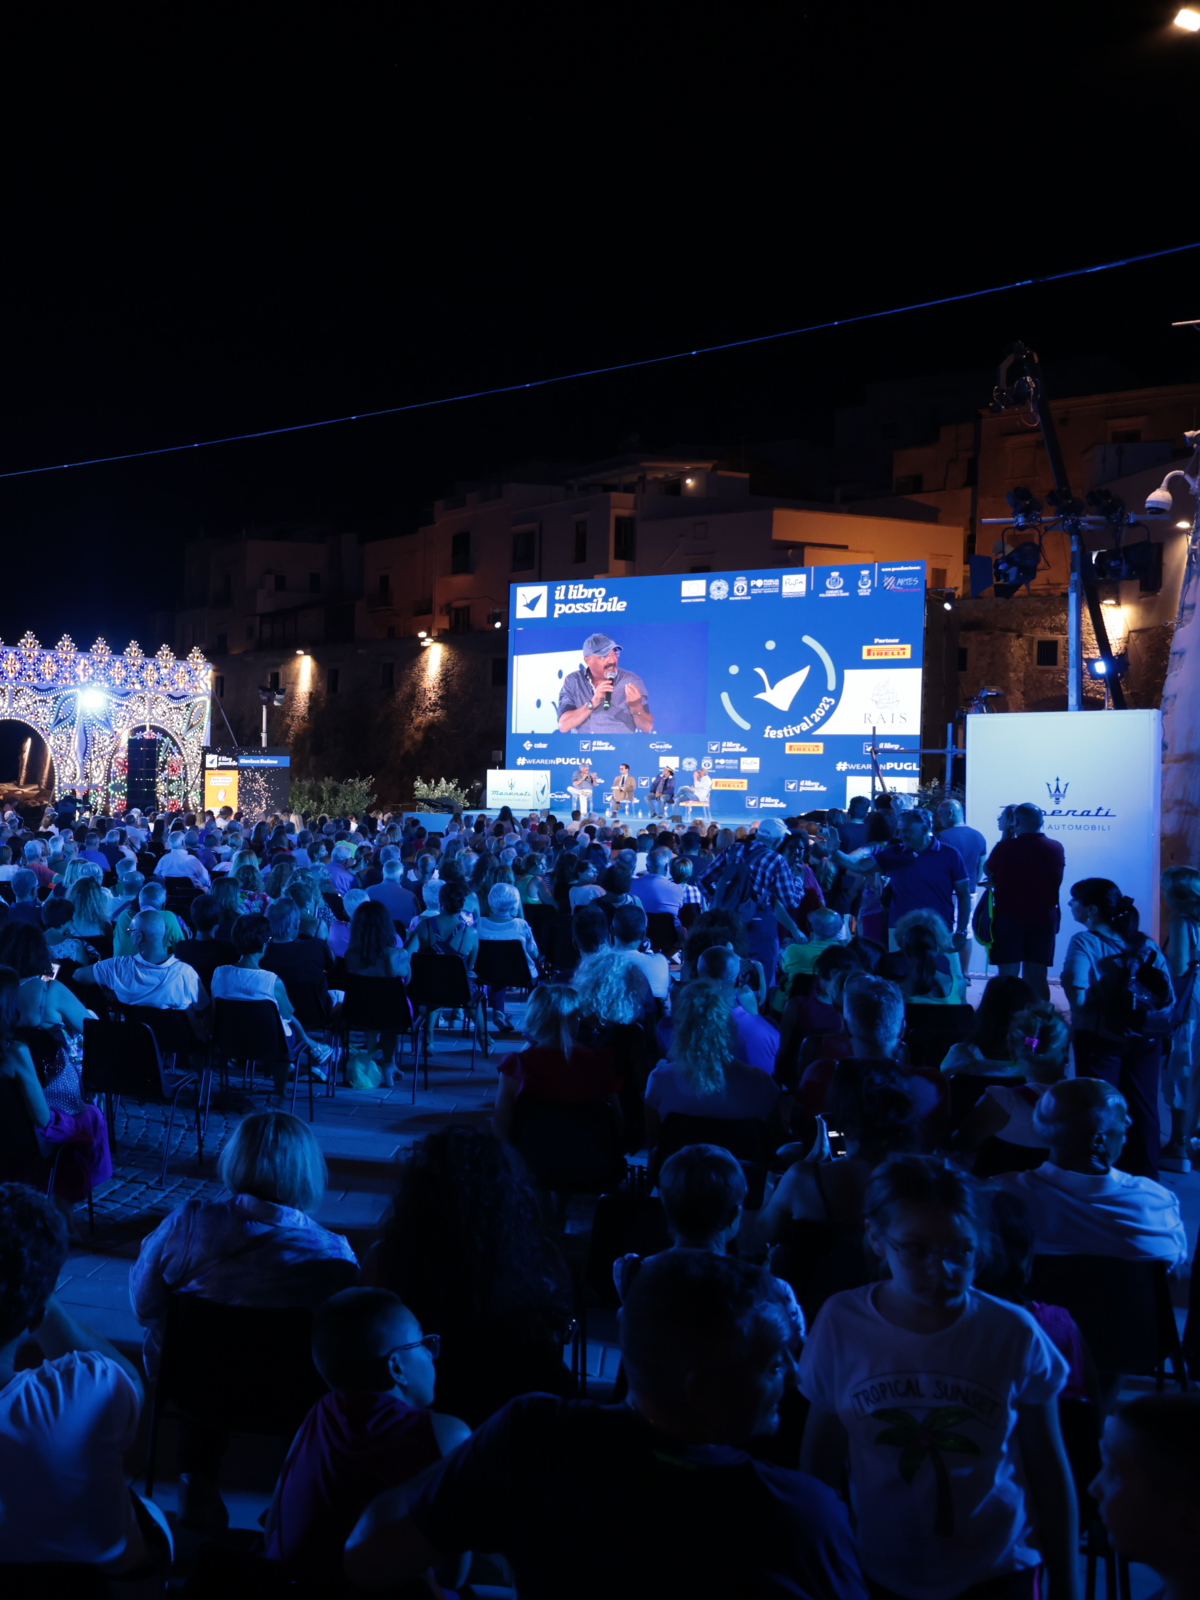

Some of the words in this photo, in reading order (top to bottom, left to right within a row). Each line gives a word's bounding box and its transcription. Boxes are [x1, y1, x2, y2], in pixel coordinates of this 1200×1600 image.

[554, 585, 566, 600] il
[567, 584, 606, 600] libro
[553, 597, 627, 618] possibile
[866, 647, 907, 657] PIRELLI
[763, 716, 814, 738] festival
[810, 696, 835, 723] 2023
[863, 712, 907, 724] RAIS
[853, 1378, 926, 1414] TROPICAL
[932, 1379, 1000, 1418] SUNSET
